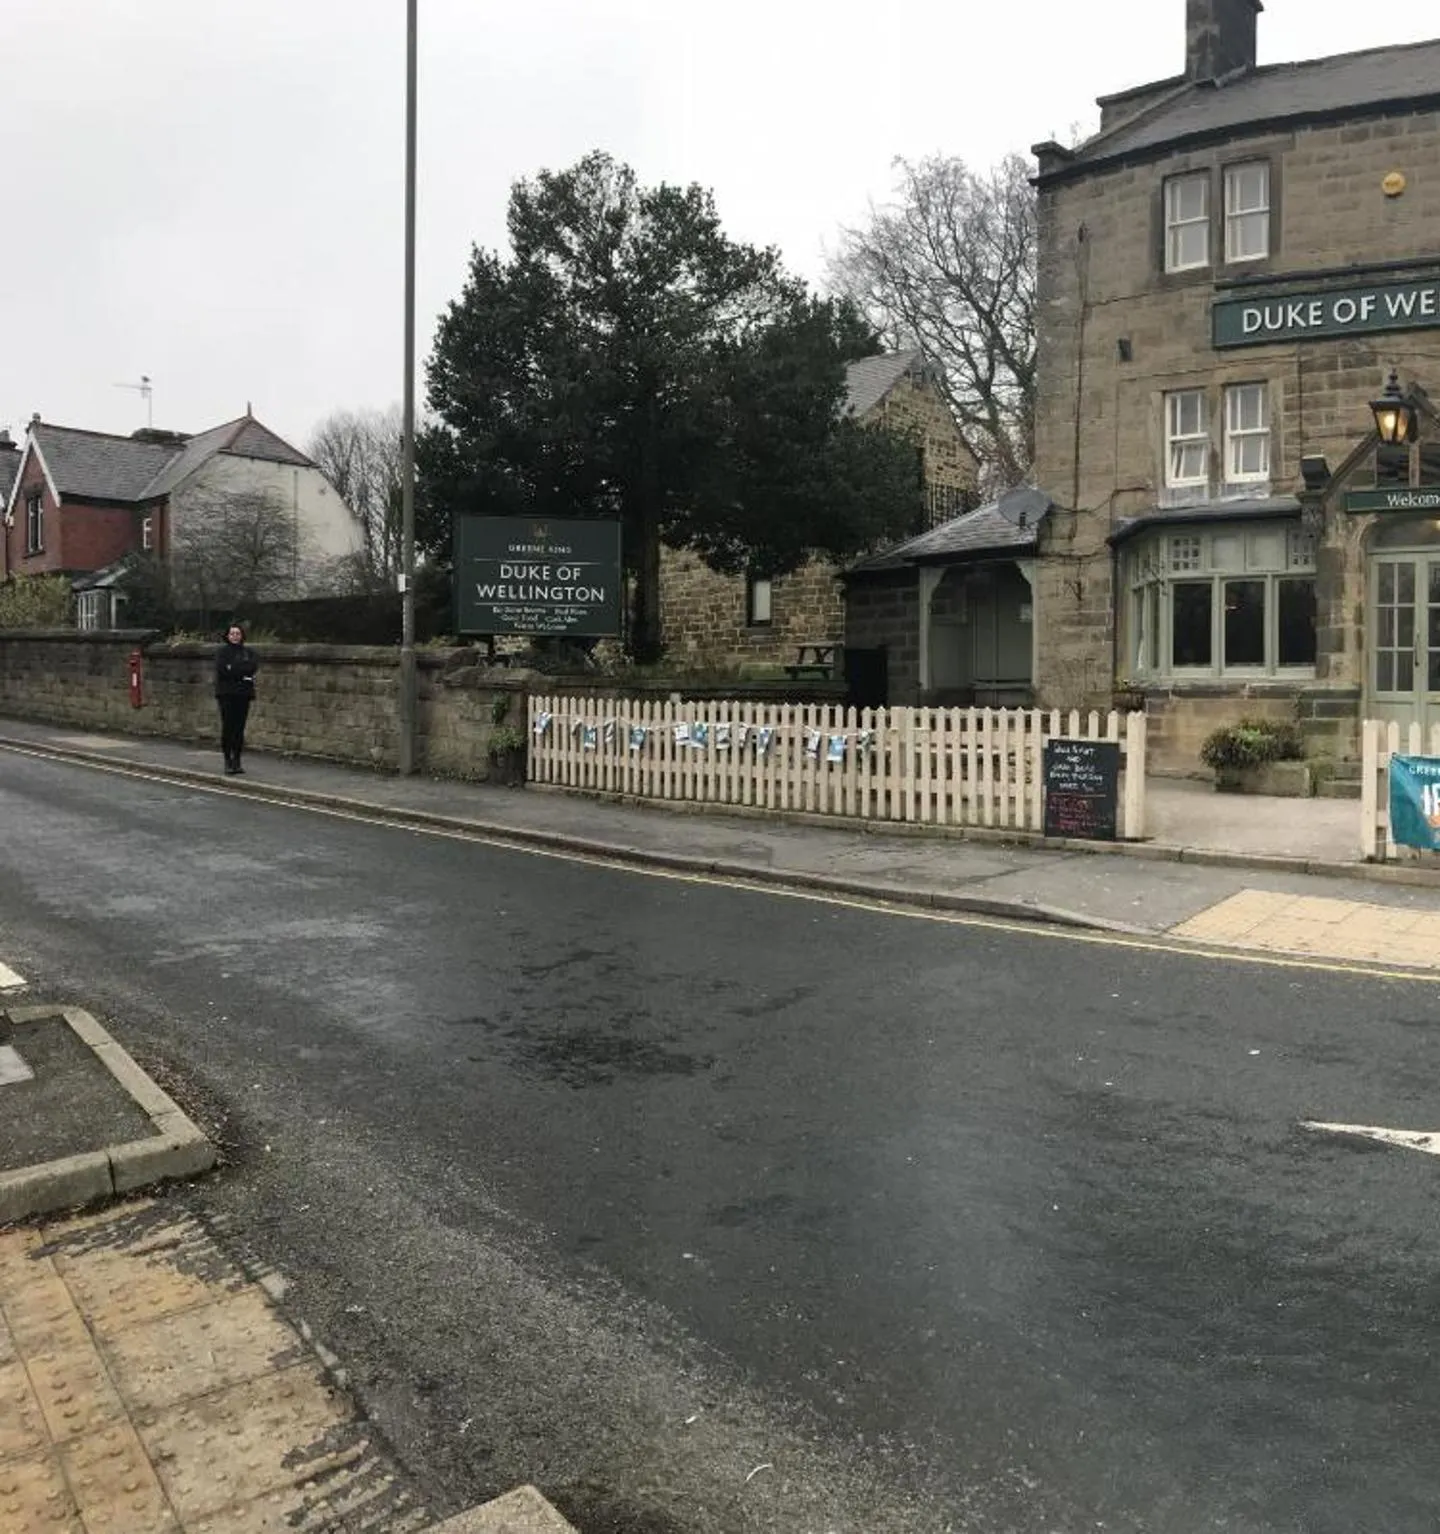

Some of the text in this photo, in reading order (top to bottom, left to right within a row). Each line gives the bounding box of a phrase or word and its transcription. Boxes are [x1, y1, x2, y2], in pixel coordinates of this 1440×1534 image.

[1242, 299, 1322, 333] DUKE
[1333, 295, 1376, 324] OF
[500, 564, 581, 581] DUKE OF
[476, 584, 604, 602] WELLINGTON
